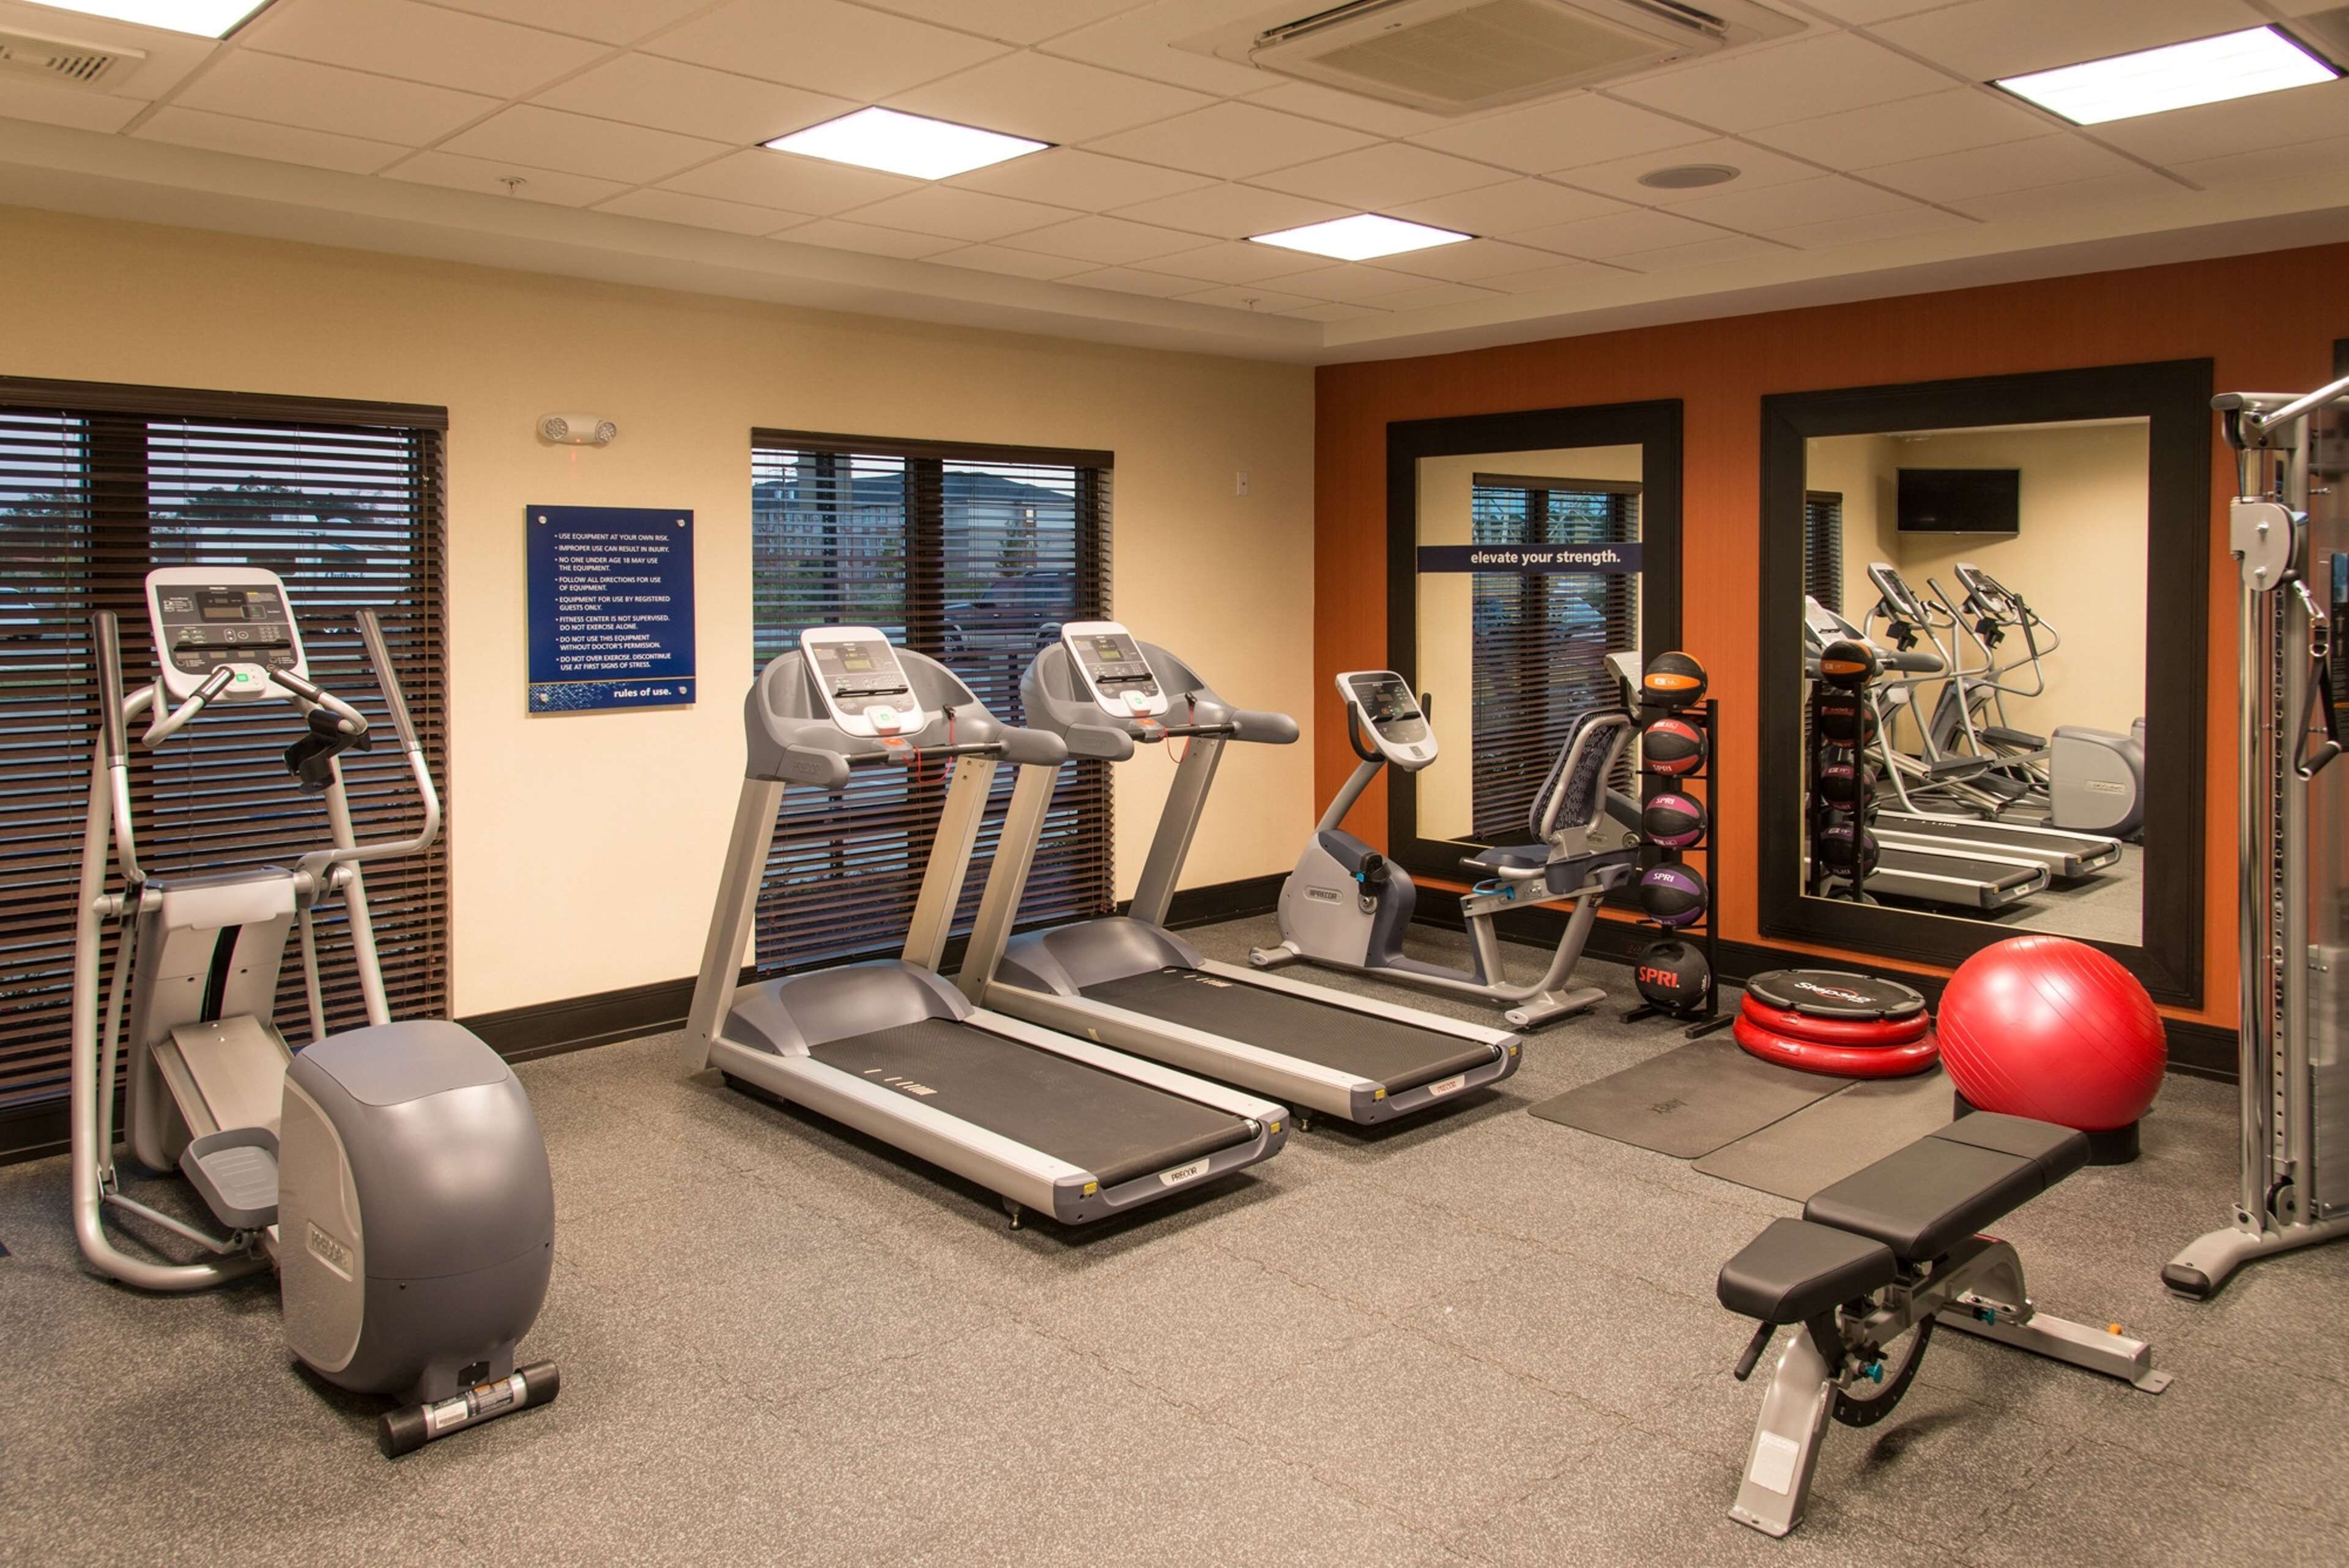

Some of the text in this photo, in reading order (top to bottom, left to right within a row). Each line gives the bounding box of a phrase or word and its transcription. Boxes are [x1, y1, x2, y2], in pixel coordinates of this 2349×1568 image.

[1471, 549, 1620, 567] elevate your strength.
[614, 688, 639, 698] rules
[640, 688, 651, 696] of
[1653, 872, 1674, 882] SPRI
[1171, 1167, 1197, 1182] PRECOR
